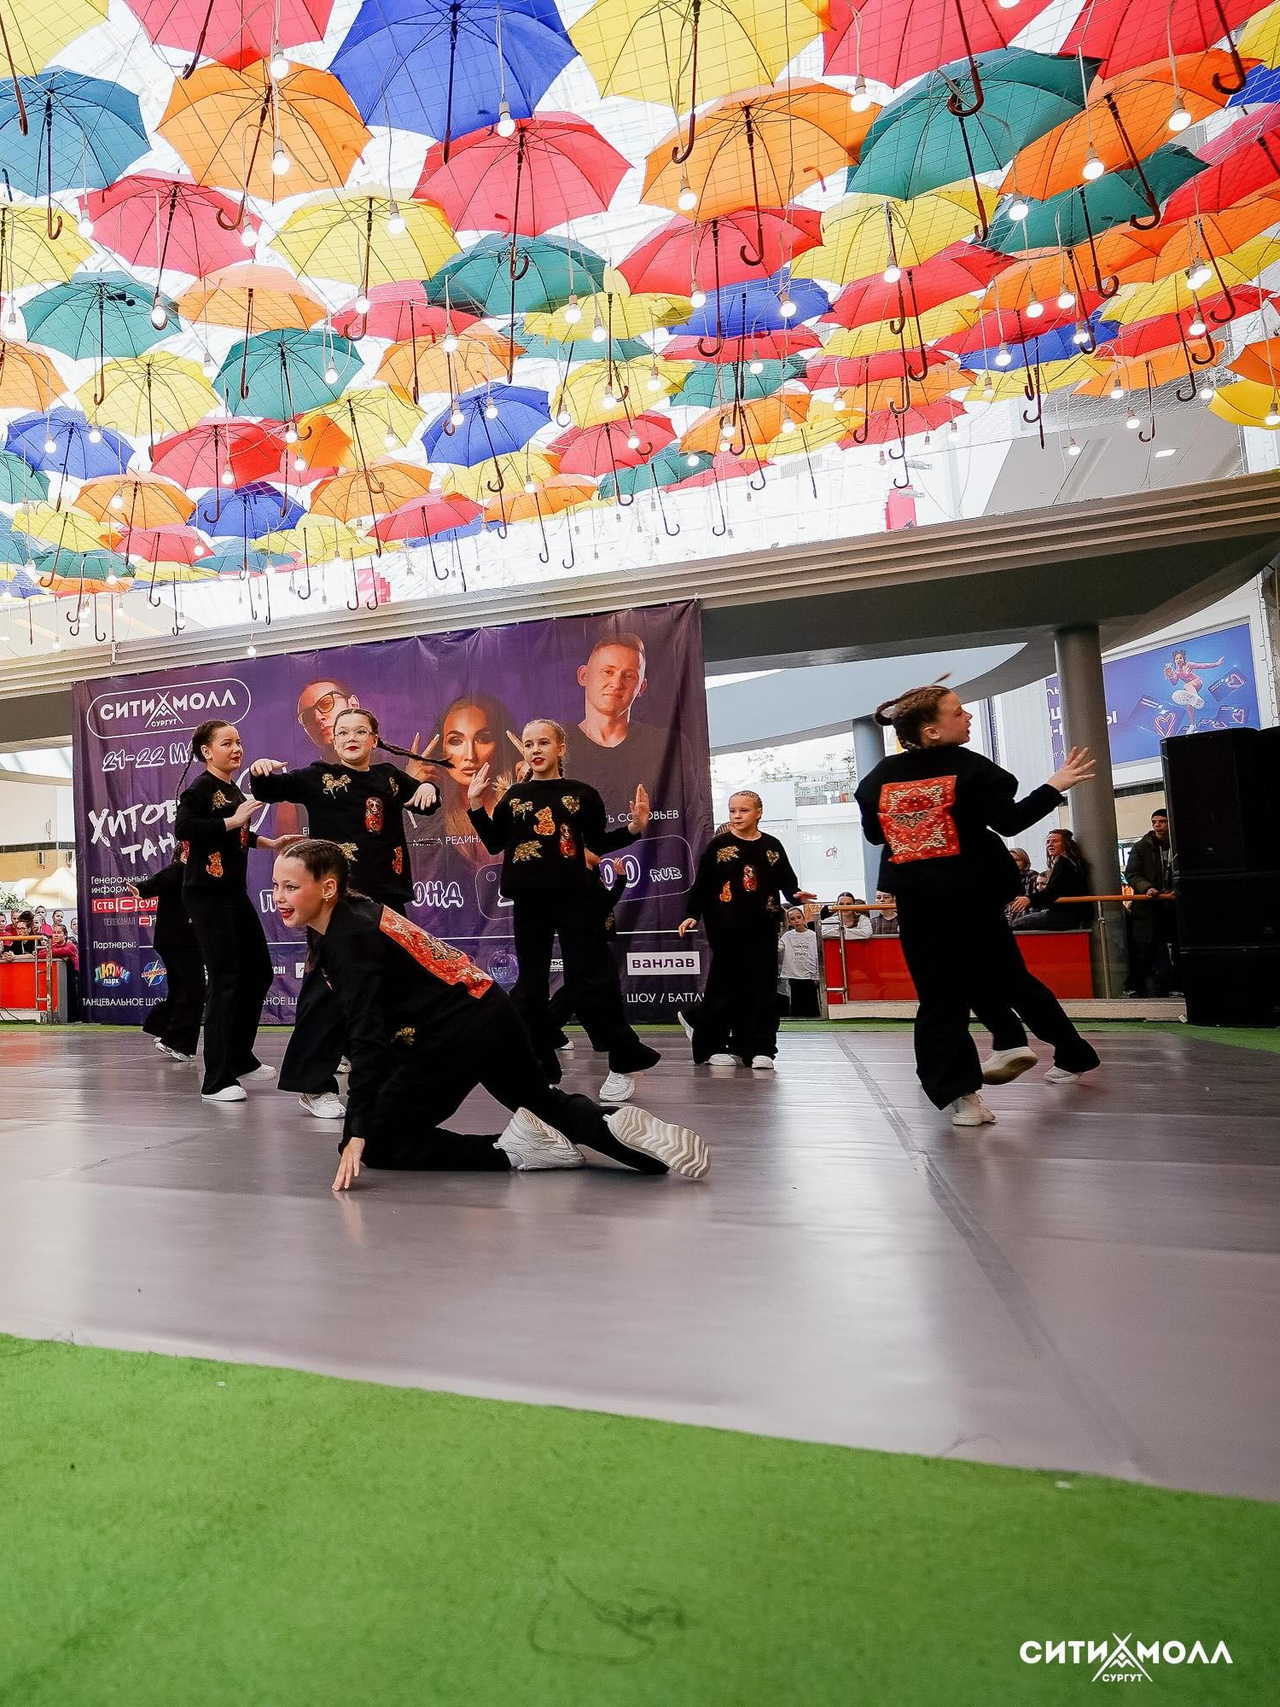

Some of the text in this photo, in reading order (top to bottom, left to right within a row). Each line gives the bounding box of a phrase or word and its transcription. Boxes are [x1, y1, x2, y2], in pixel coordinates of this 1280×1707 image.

[150, 718, 178, 728] СУРГУТ
[102, 747, 166, 772] 21-22
[445, 835, 482, 845] РЕДИН
[120, 832, 177, 864] ТАН
[90, 873, 149, 885] Генеральный
[649, 867, 683, 882] RUB
[91, 885, 131, 895] информ
[411, 880, 465, 909] ОНА
[93, 940, 137, 951] Партнеры:
[632, 958, 695, 969] ванлав
[82, 997, 144, 1007] ТАНЦЕВАЛЬНОЕ
[626, 992, 656, 1003] ШОУ
[668, 992, 704, 1003] БАТТЛ
